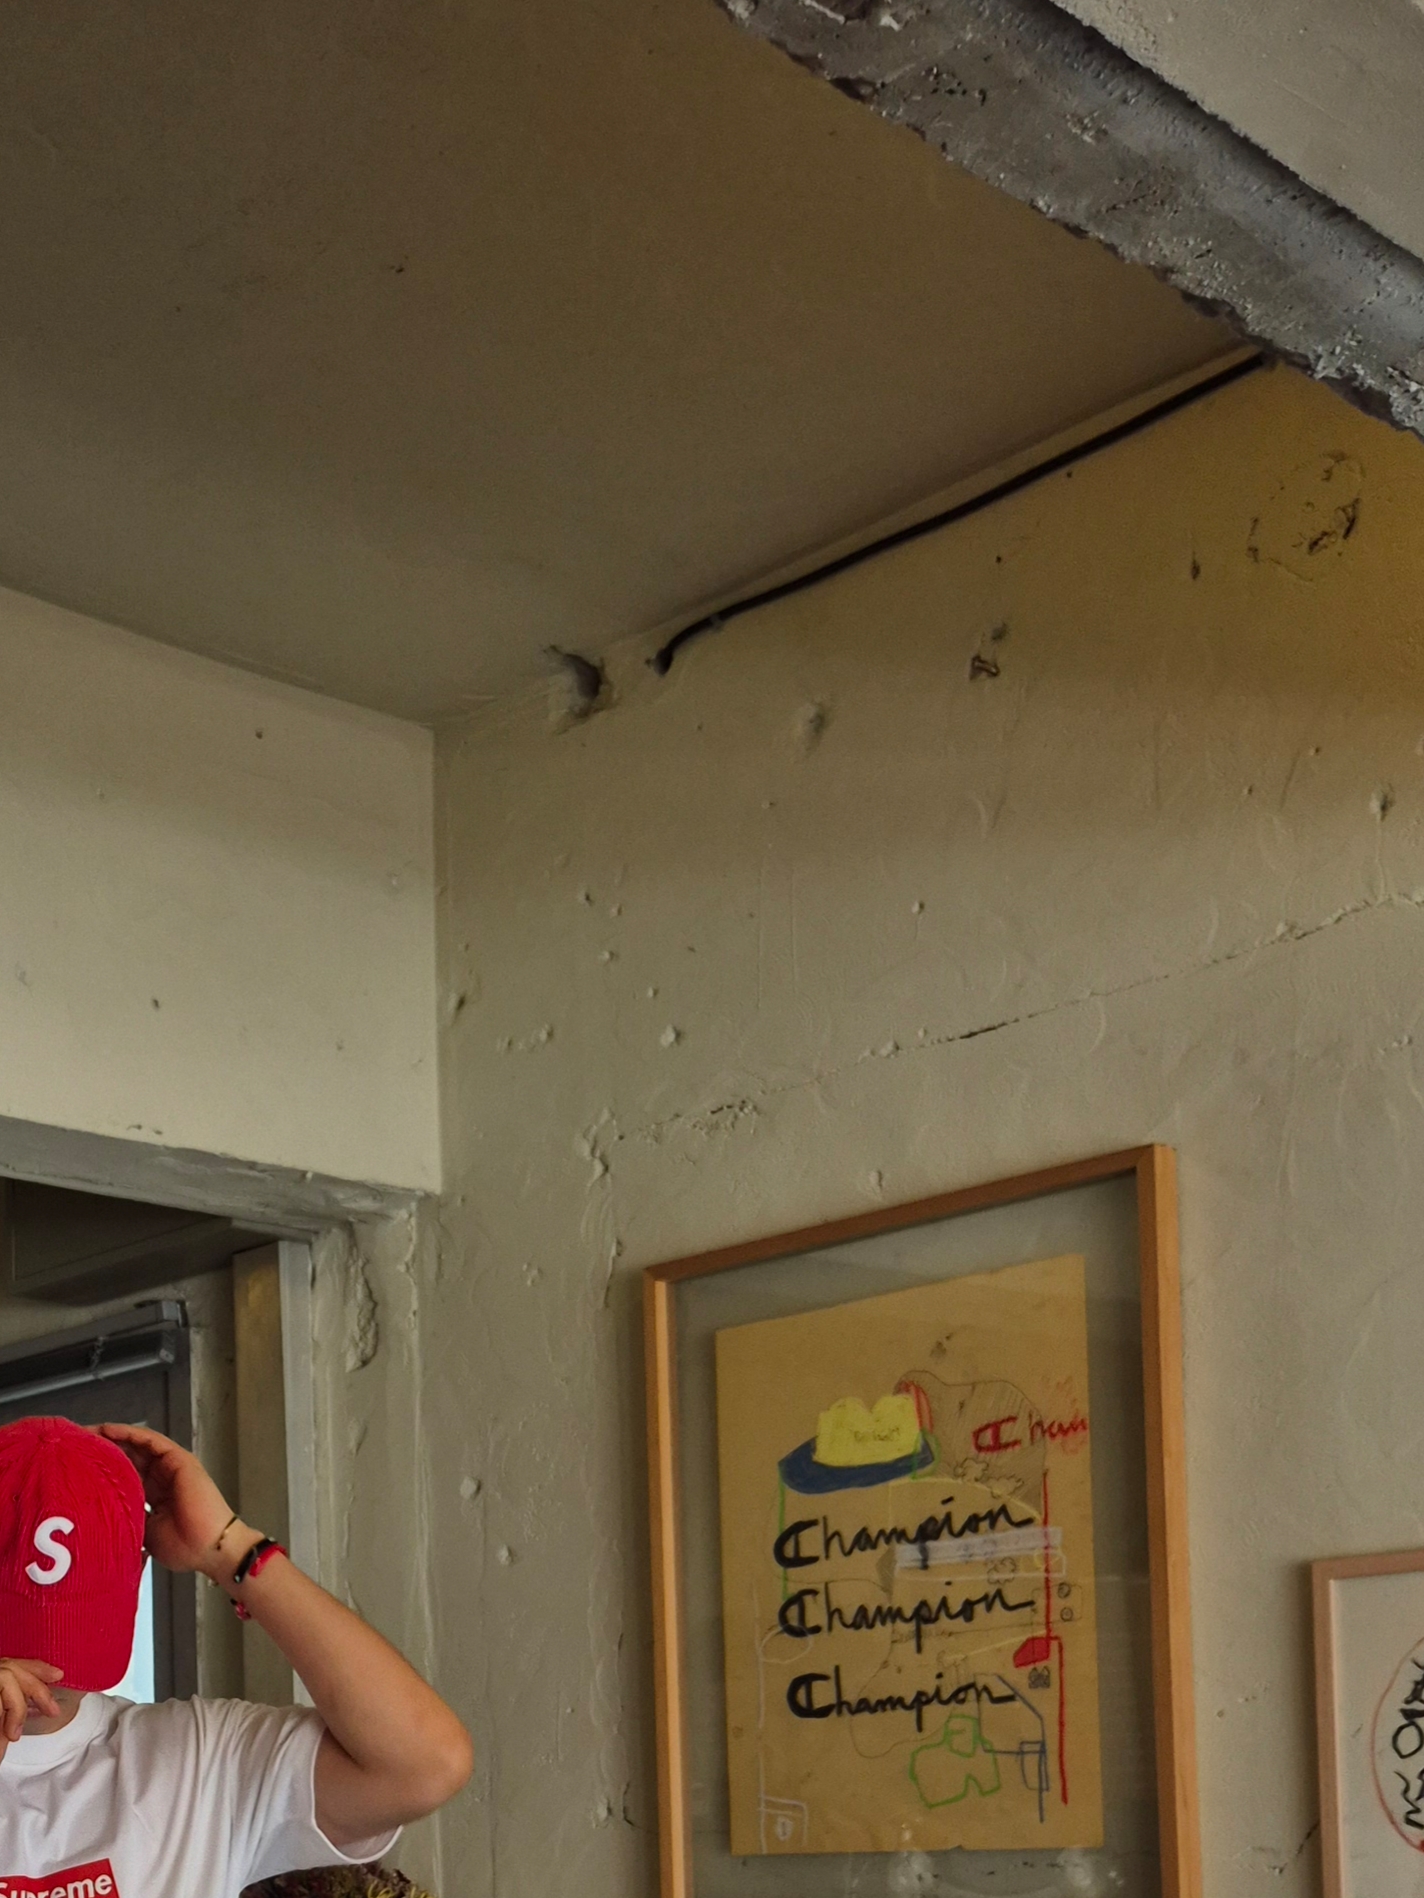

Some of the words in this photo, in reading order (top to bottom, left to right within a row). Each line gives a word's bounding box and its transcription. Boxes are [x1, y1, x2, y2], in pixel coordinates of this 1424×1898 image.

[25, 1515, 76, 1586] S
[774, 1496, 1035, 1570] Champion
[778, 1581, 1036, 1654] Champion
[786, 1664, 1018, 1733] Champion
